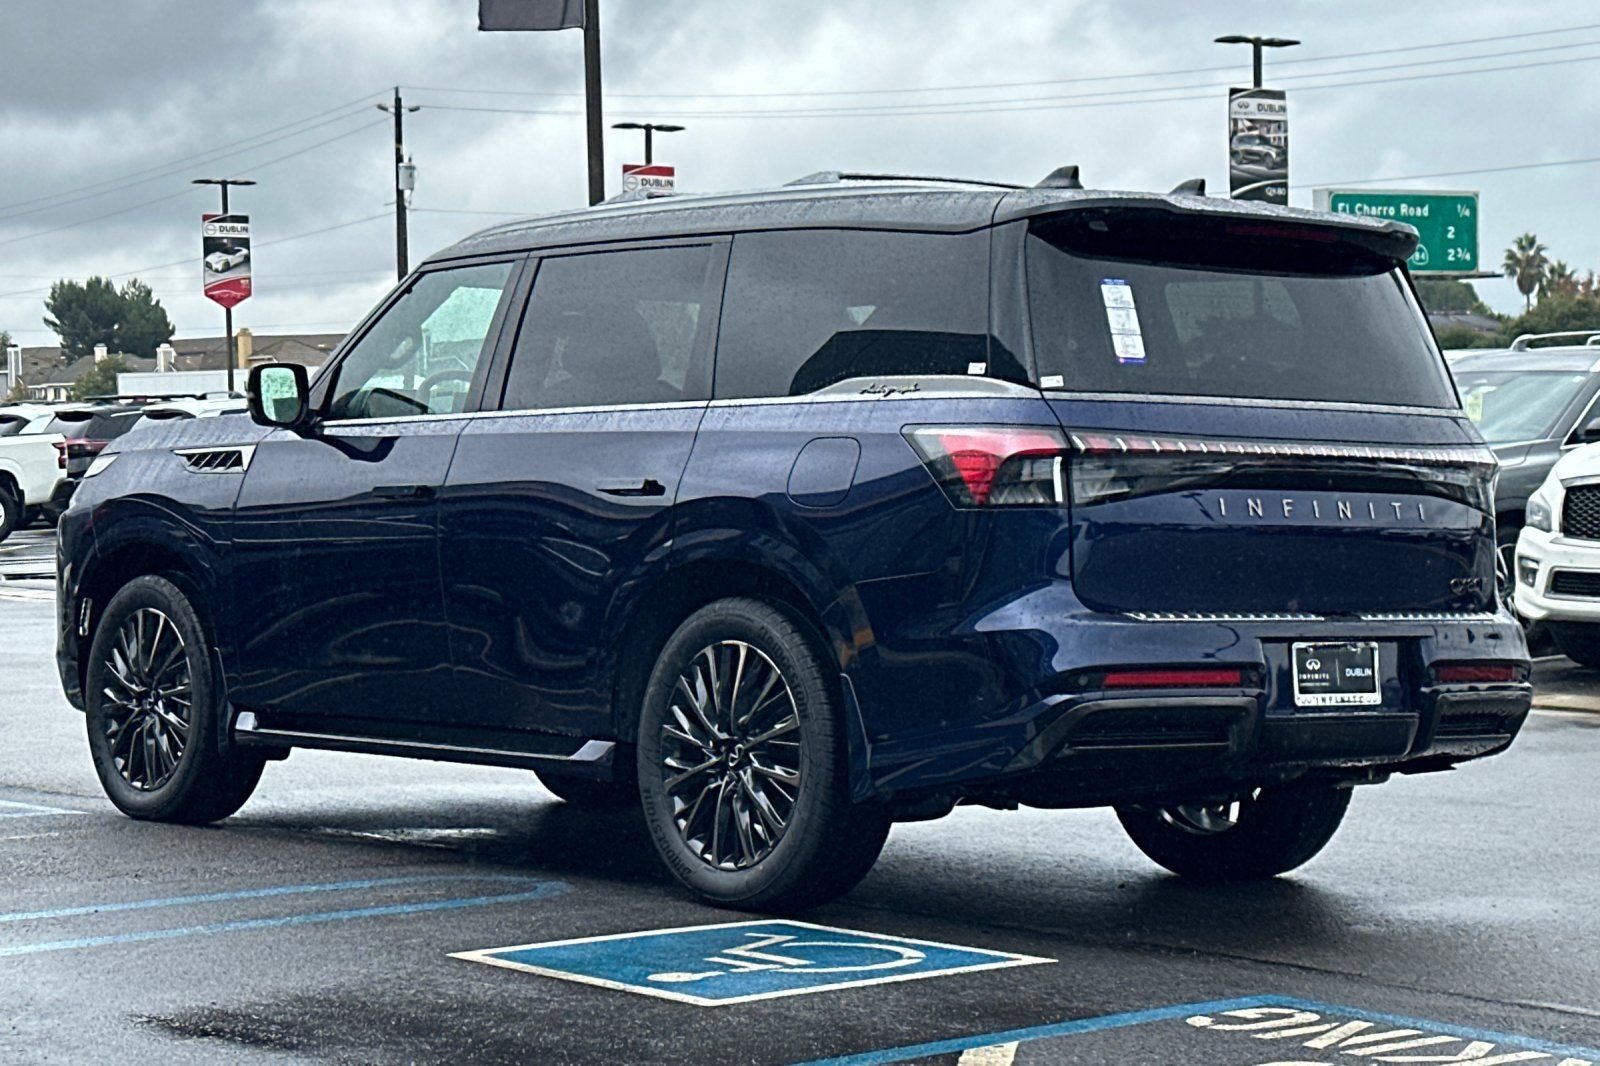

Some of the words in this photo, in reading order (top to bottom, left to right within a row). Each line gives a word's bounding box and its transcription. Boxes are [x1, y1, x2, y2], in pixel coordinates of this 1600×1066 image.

[640, 178, 673, 187] DUBLIN
[1355, 204, 1395, 216] Charro
[1401, 204, 1429, 217] Road
[219, 225, 249, 233] DUBLIN
[1446, 226, 1455, 239] 2
[1219, 497, 1425, 521] INFINITI
[1345, 667, 1372, 677] DUBLIN
